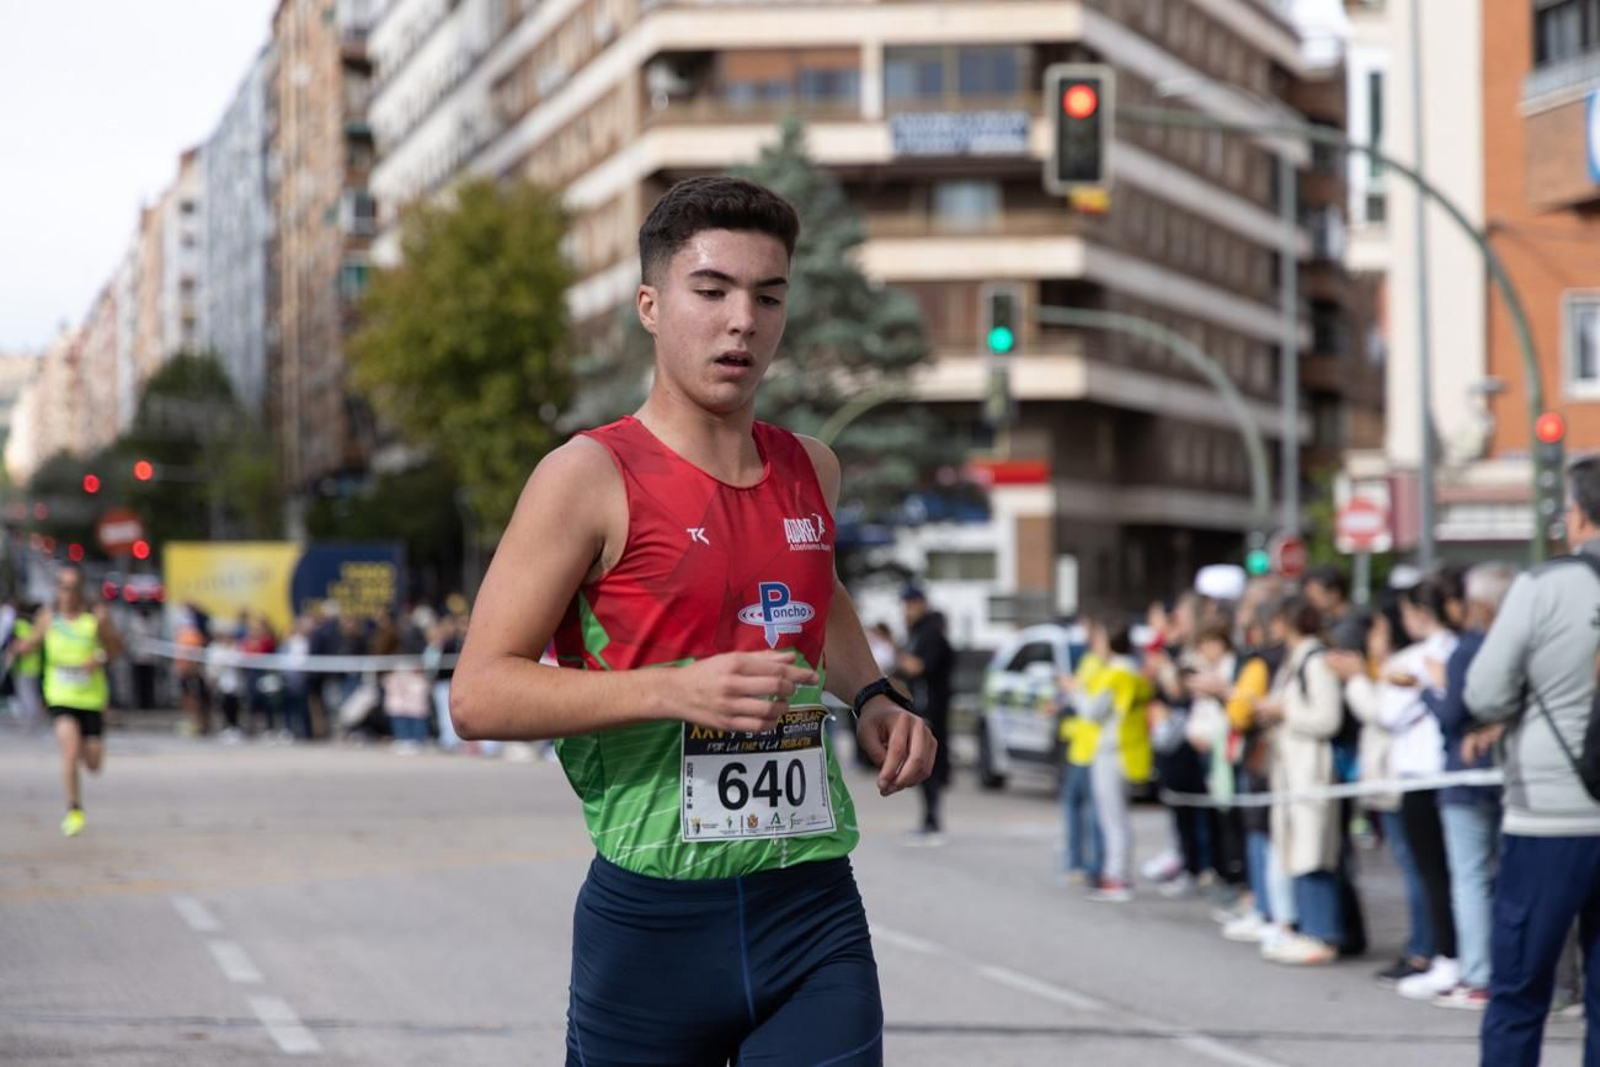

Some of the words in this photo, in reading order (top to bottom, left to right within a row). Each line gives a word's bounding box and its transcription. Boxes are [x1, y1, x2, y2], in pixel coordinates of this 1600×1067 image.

[760, 583, 807, 622] Poncho
[783, 721, 819, 734] caminata
[718, 758, 806, 811] 640
